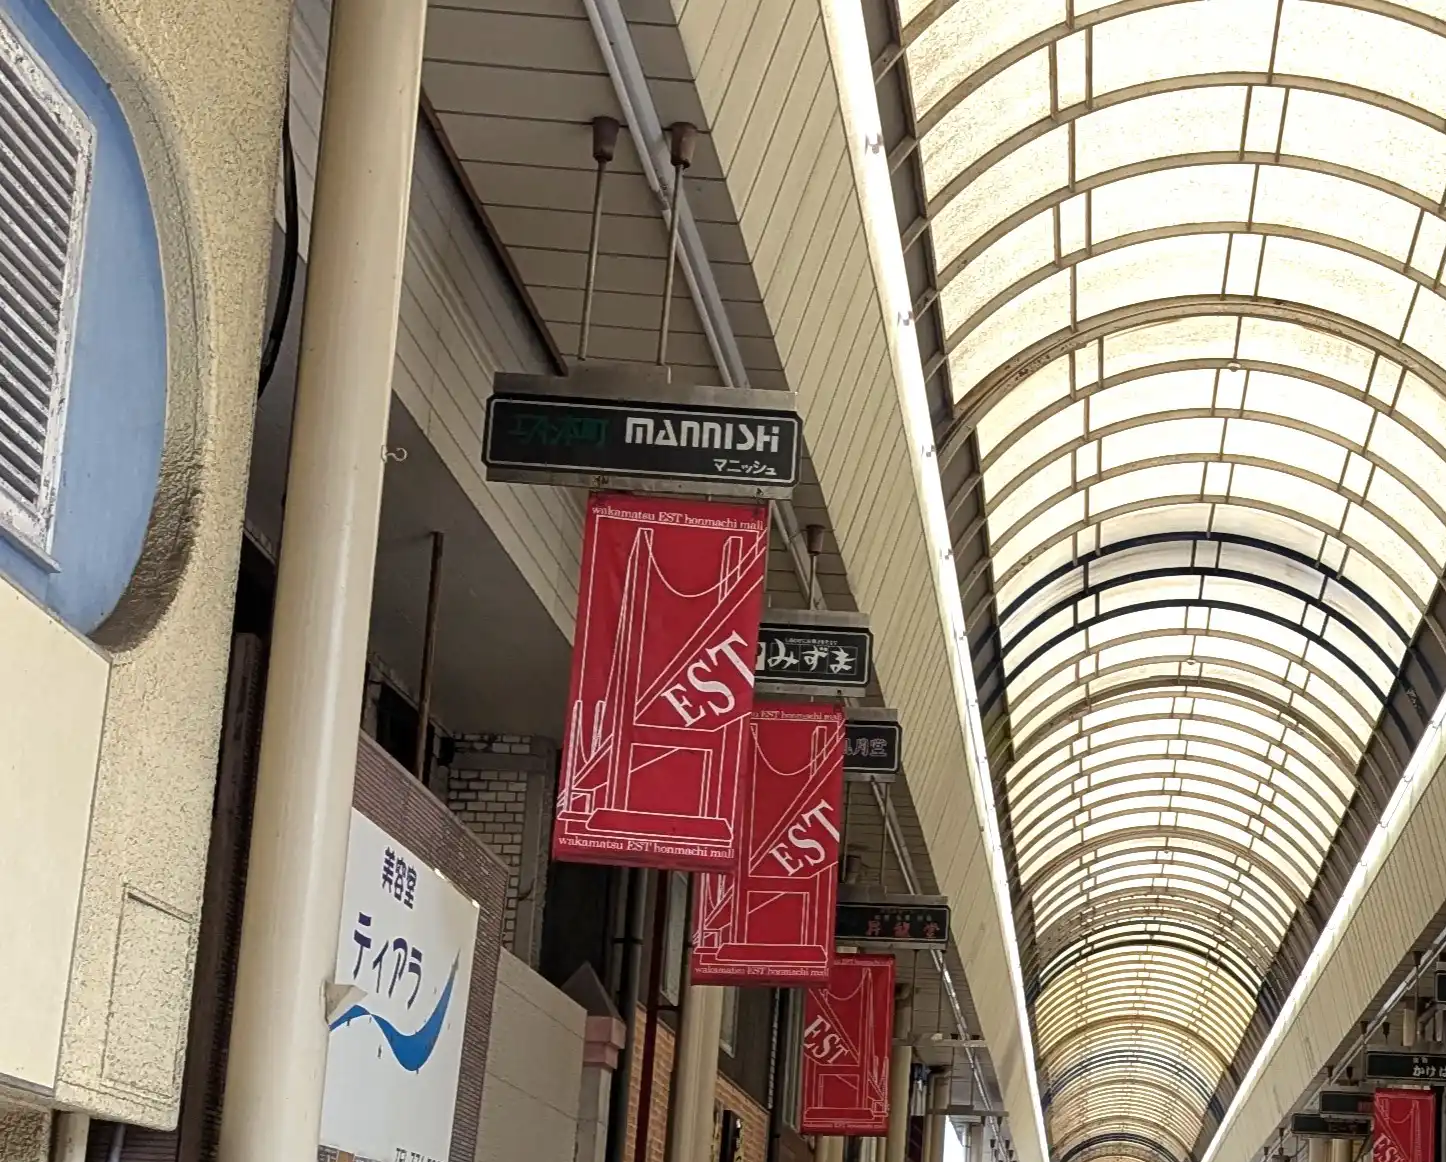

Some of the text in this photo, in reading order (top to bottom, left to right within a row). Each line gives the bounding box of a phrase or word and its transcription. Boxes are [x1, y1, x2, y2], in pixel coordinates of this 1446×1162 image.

[712, 458, 778, 476] マニッシュ
[591, 506, 765, 531] wakamatsu EST honmachi mall
[660, 629, 756, 728] EST
[558, 836, 735, 859] wakamatsu EST honmachi mall
[768, 798, 842, 877] EST
[381, 846, 418, 910] 美容室
[352, 911, 423, 1011] ティアラ
[803, 1014, 850, 1066] EST
